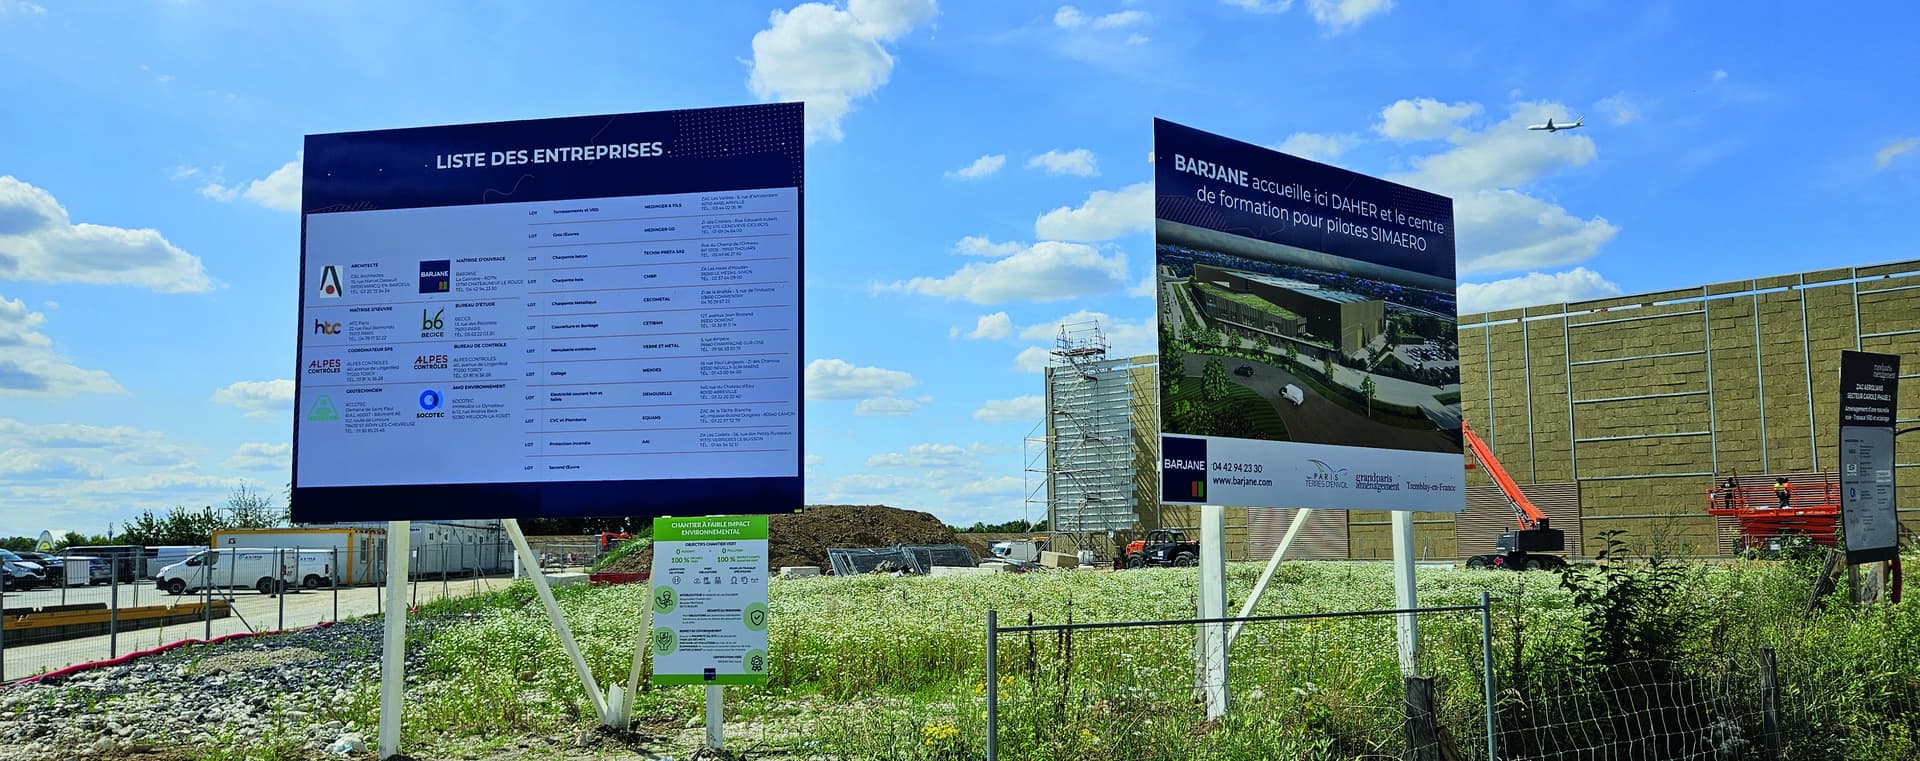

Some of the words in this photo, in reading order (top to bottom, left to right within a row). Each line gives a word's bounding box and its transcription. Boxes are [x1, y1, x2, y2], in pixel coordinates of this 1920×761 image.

[437, 153, 485, 169] LISTE
[492, 150, 527, 166] DES
[534, 142, 663, 163] ENTREPRISES
[1175, 153, 1248, 187] BARJANE
[1252, 177, 1311, 202] accueille
[1314, 189, 1328, 206] ici
[1332, 194, 1377, 219] DAHER
[1381, 209, 1392, 222] et
[1395, 209, 1405, 224] le
[1408, 216, 1444, 234] centre
[1197, 185, 1215, 204] de
[1219, 190, 1288, 221] formation
[1294, 211, 1323, 228] pour
[1328, 217, 1368, 238] pilotes
[1371, 226, 1426, 251] SIMAERO
[315, 318, 341, 335] htc
[309, 359, 341, 368] ALPES
[415, 355, 448, 364] ALPES
[1164, 459, 1205, 470] BARJANE
[1213, 462, 1221, 471] 04
[1223, 463, 1232, 471] 42
[1234, 464, 1242, 472] 94
[1244, 464, 1252, 472] 23
[1254, 464, 1262, 473] 30
[1213, 476, 1272, 487] www.barjane.com
[1406, 481, 1456, 493] Tremblay-en-France
